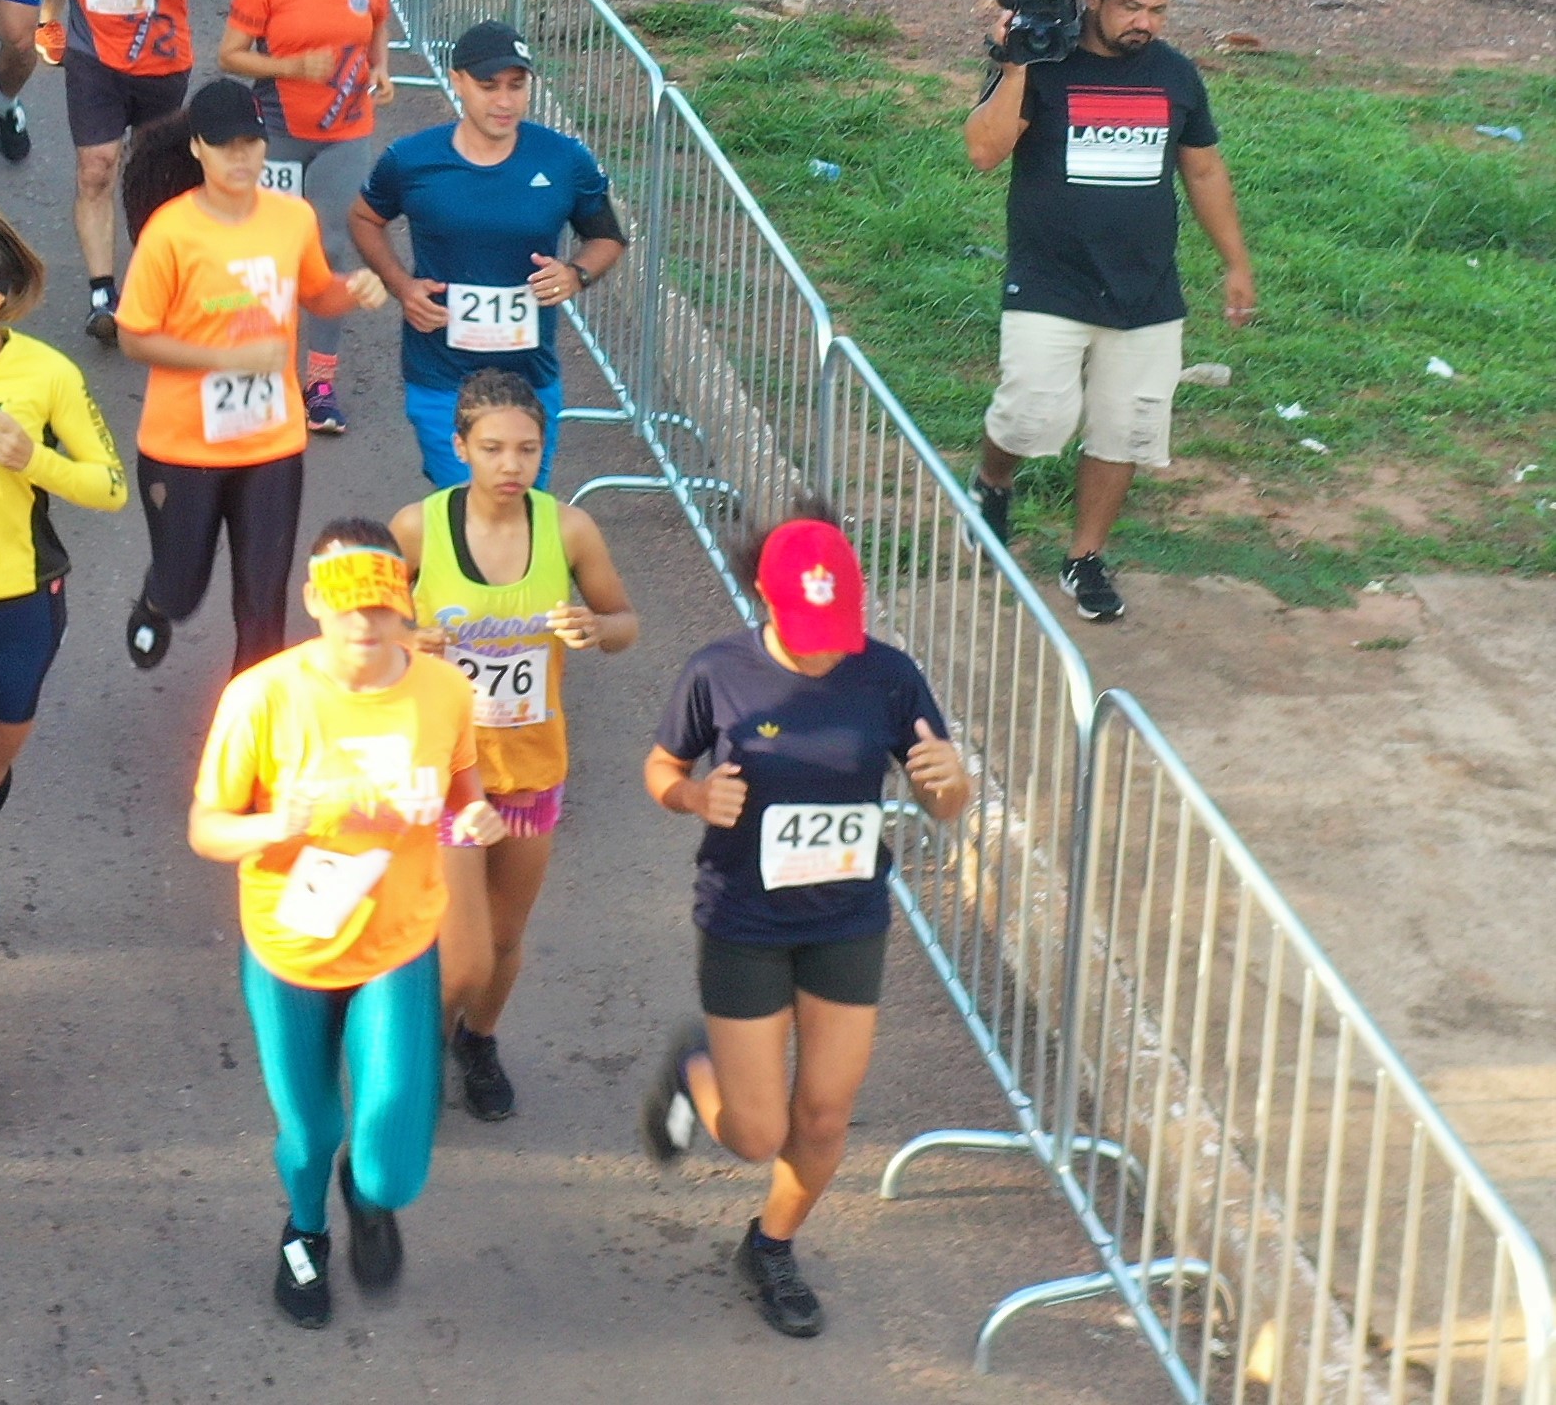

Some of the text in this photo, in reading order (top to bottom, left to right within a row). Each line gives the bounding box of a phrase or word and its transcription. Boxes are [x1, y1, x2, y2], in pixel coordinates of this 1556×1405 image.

[1068, 125, 1169, 146] LACOSTE
[461, 290, 528, 325] 215
[776, 812, 864, 849] 426
